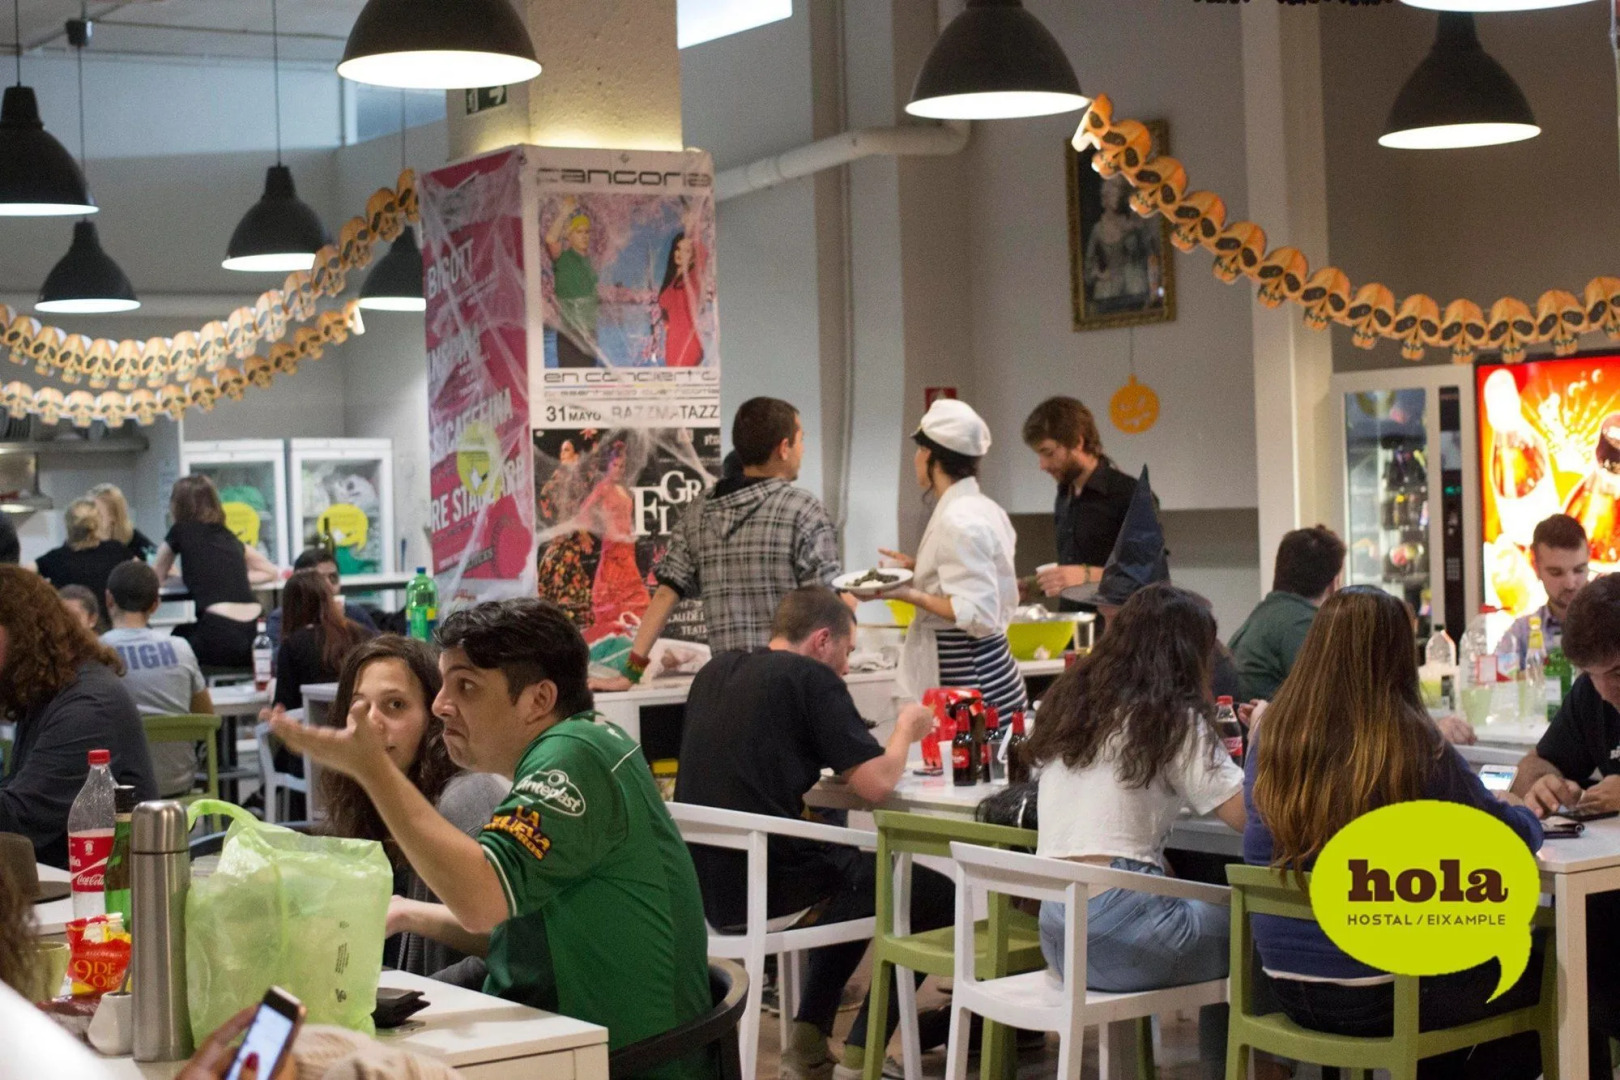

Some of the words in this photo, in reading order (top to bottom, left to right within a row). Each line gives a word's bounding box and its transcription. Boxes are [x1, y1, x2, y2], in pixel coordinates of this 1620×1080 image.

[545, 405, 567, 423] 31
[568, 411, 602, 422] MAYO
[74, 959, 92, 983] 9
[94, 961, 116, 975] DE
